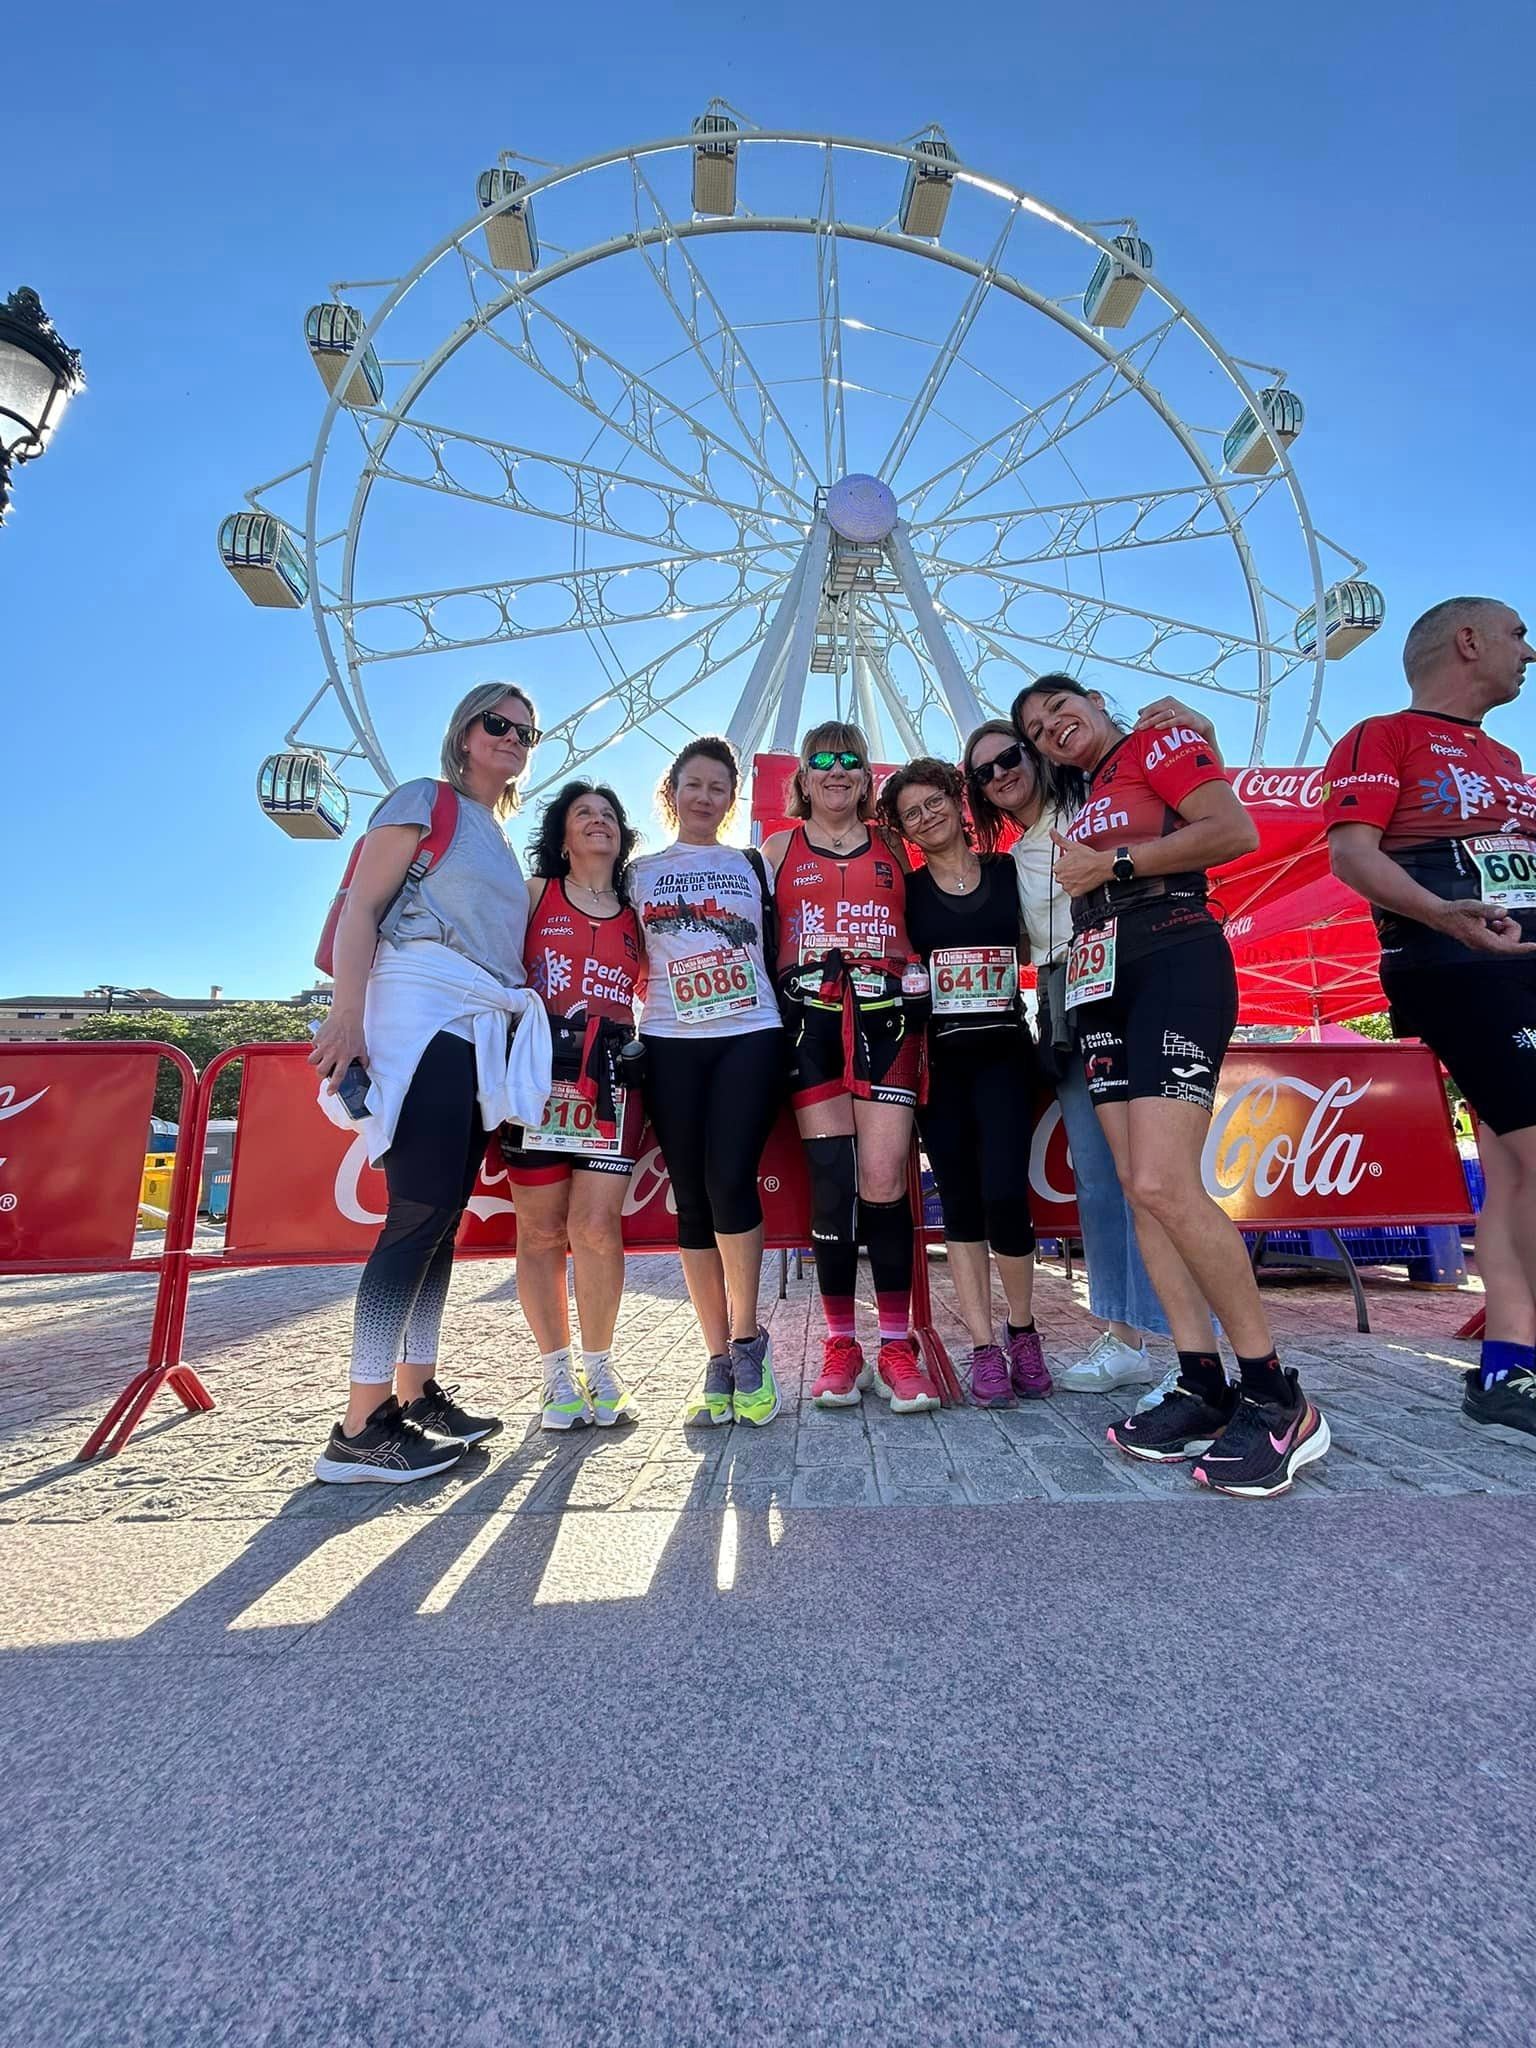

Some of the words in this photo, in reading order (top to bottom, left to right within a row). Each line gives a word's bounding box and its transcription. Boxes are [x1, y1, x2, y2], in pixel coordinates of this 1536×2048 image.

[1146, 740, 1166, 770] el
[1162, 727, 1209, 751] Va
[1073, 797, 1112, 821] dro
[1066, 815, 1128, 842] rdán
[1475, 839, 1493, 852] 40
[653, 884, 689, 897] CIUDAD
[692, 882, 705, 892] DE
[708, 880, 752, 893] GRANADA
[655, 874, 675, 887] 40
[675, 875, 705, 886] MEDIA
[708, 873, 749, 885] MARATÓN
[837, 900, 890, 918] Pedro
[836, 918, 896, 937] Cerdán
[804, 935, 816, 947] 40
[936, 952, 950, 965] 40
[584, 958, 632, 988] Pedro
[672, 961, 686, 975] 40
[675, 965, 747, 1002] 6086
[938, 966, 1006, 992] 6417
[1086, 1032, 1112, 1042] Pedro
[1088, 1038, 1123, 1048] Cerdán
[878, 1092, 914, 1105] UNIDOS
[541, 1100, 599, 1130] 10
[1200, 1076, 1373, 1198] Cola
[589, 1161, 628, 1172] UNIDOS
